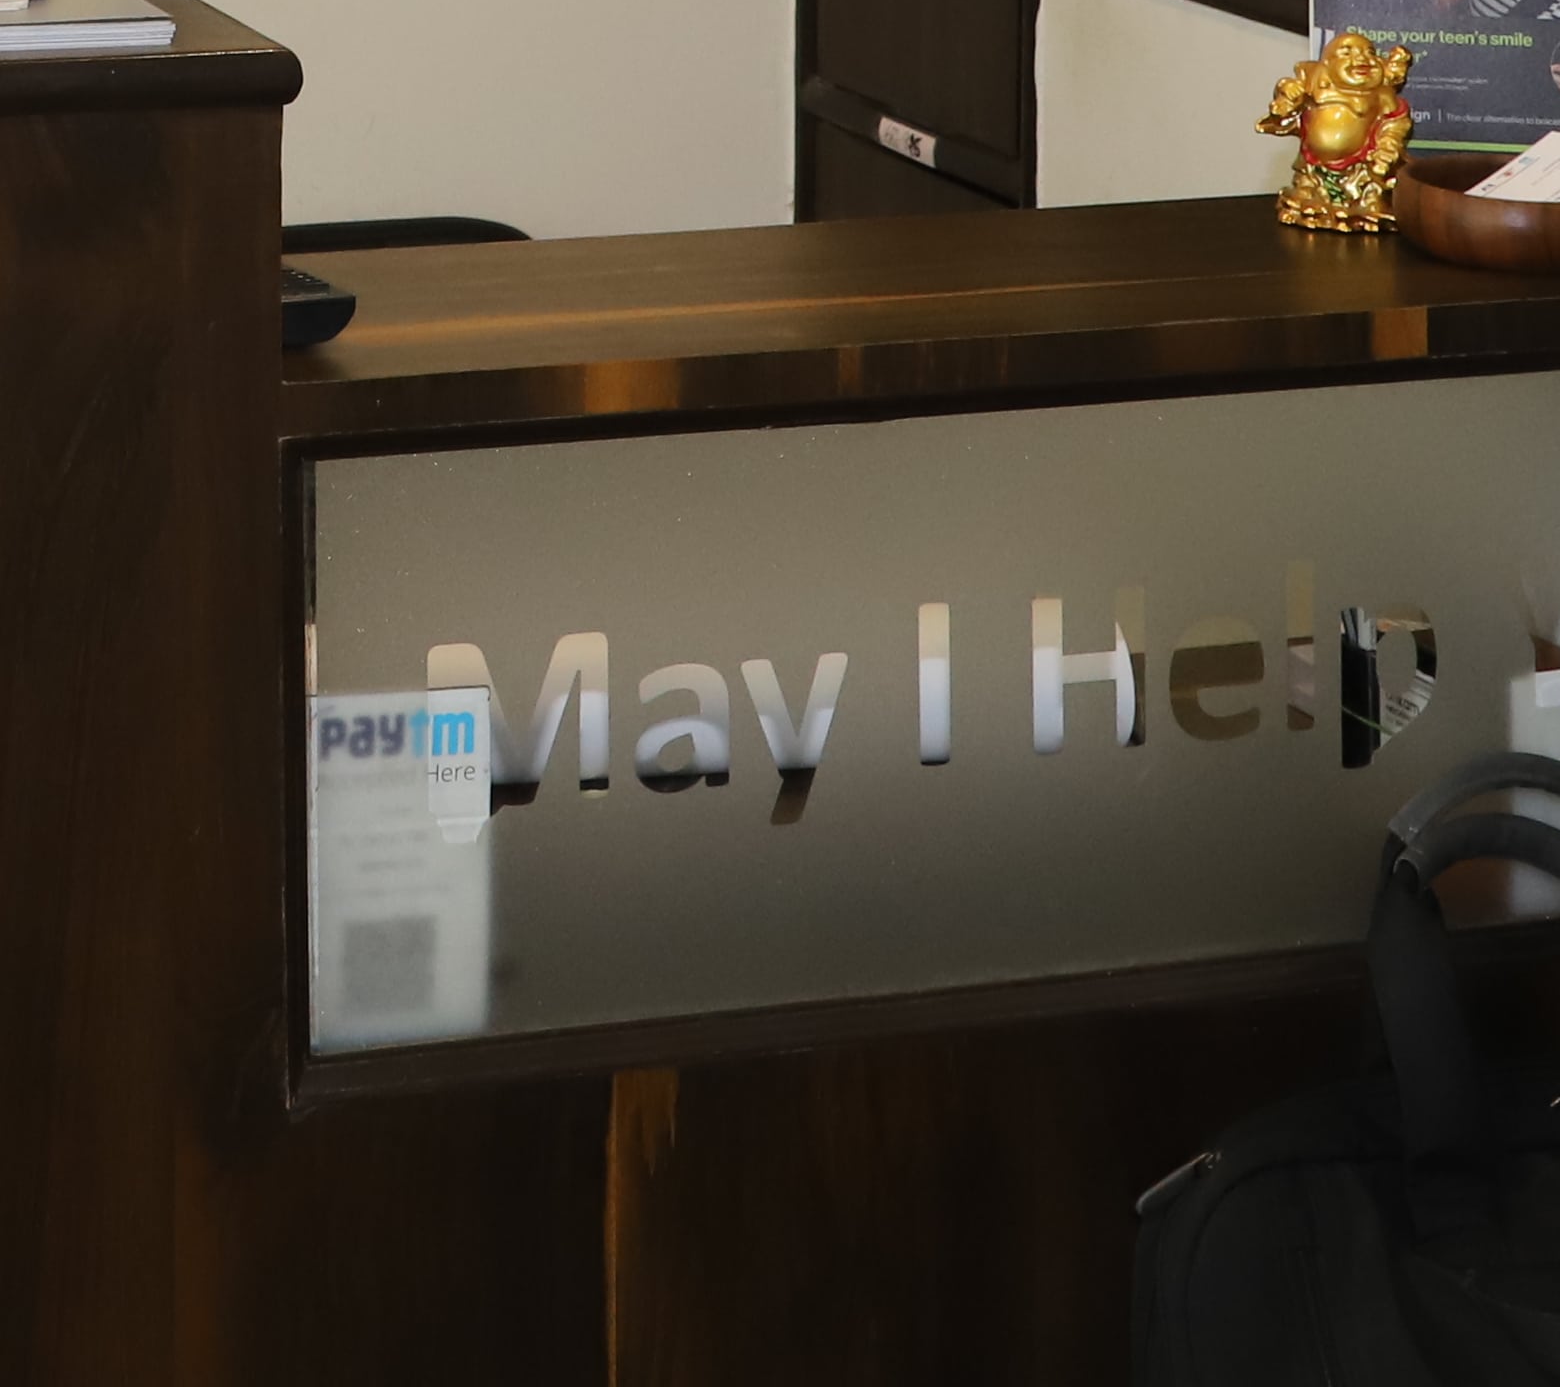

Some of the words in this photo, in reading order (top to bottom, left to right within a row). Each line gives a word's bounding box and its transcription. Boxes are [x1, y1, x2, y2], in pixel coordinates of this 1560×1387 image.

[1400, 30, 1436, 48] your
[1439, 29, 1488, 46] teen's
[1490, 32, 1534, 48] smile
[427, 630, 849, 825] May
[918, 601, 951, 767] I
[1032, 560, 1438, 769] Help
